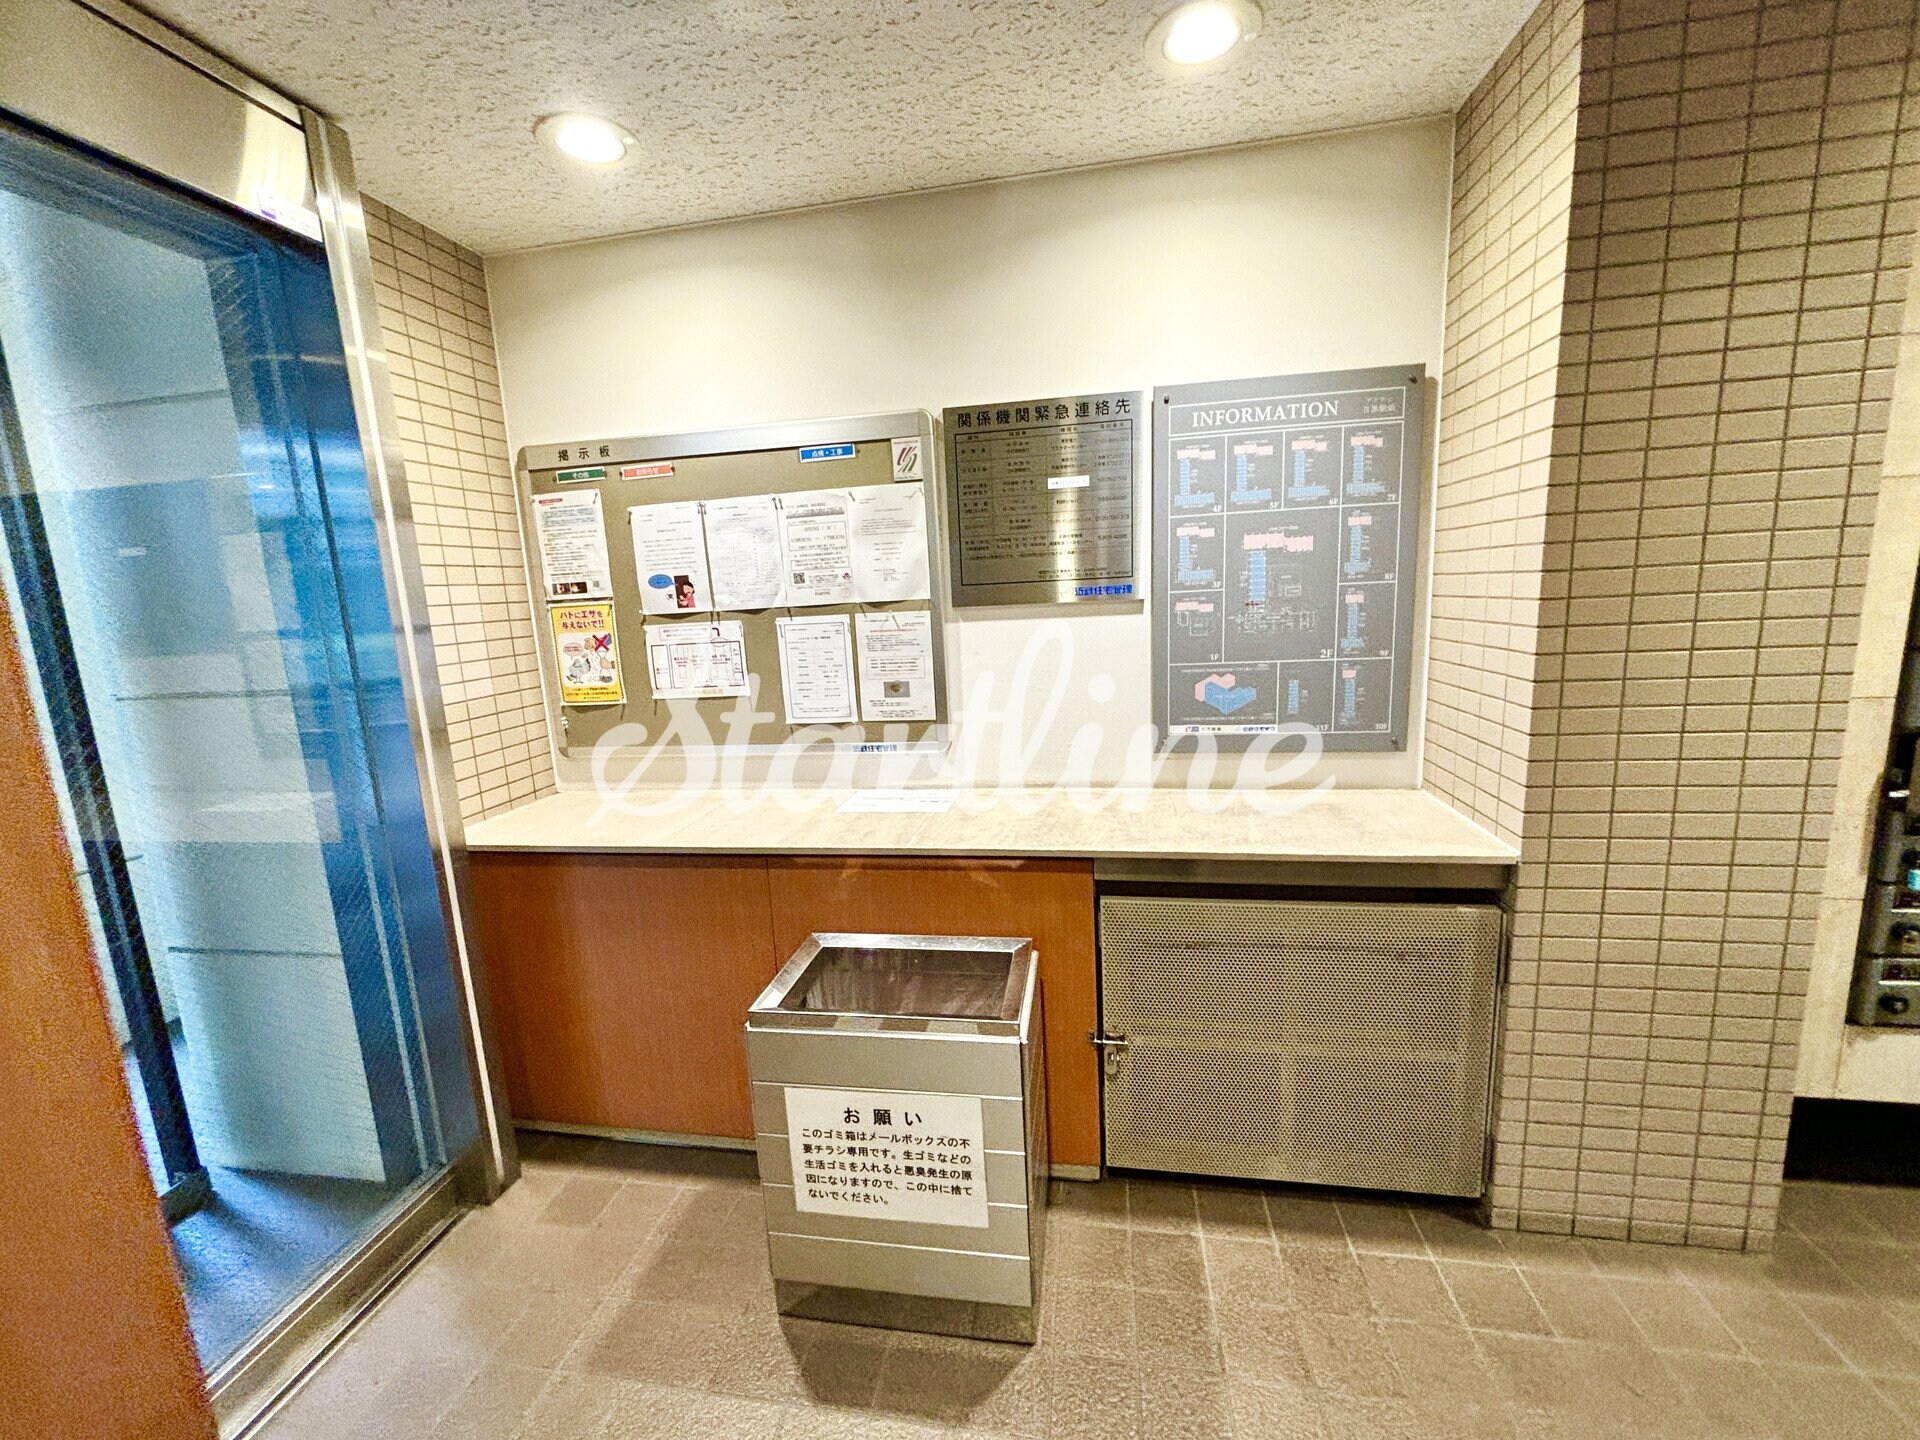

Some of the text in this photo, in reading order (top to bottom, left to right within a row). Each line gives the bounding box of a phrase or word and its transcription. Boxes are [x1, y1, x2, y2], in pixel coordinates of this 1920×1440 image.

[957, 399, 1131, 428] 関係機関緊急連絡先
[1192, 400, 1338, 427] INFORMATION
[557, 445, 611, 462] 掲示板
[1212, 505, 1223, 513] 4F
[1269, 501, 1279, 509] 5F
[560, 610, 603, 619] ハトにエサを
[1320, 649, 1333, 659] 2F
[843, 1107, 923, 1126] お願い
[801, 1128, 971, 1149] このゴミ箱はメールボックスの不
[803, 1144, 972, 1165] 要チラシ専用です。生ゴミなどの
[804, 1160, 973, 1181] 生活ゴミを入れると悪臭発生の原
[806, 1174, 973, 1196] 因になりますので、この中に捨て
[808, 1188, 890, 1205] ないでください。
